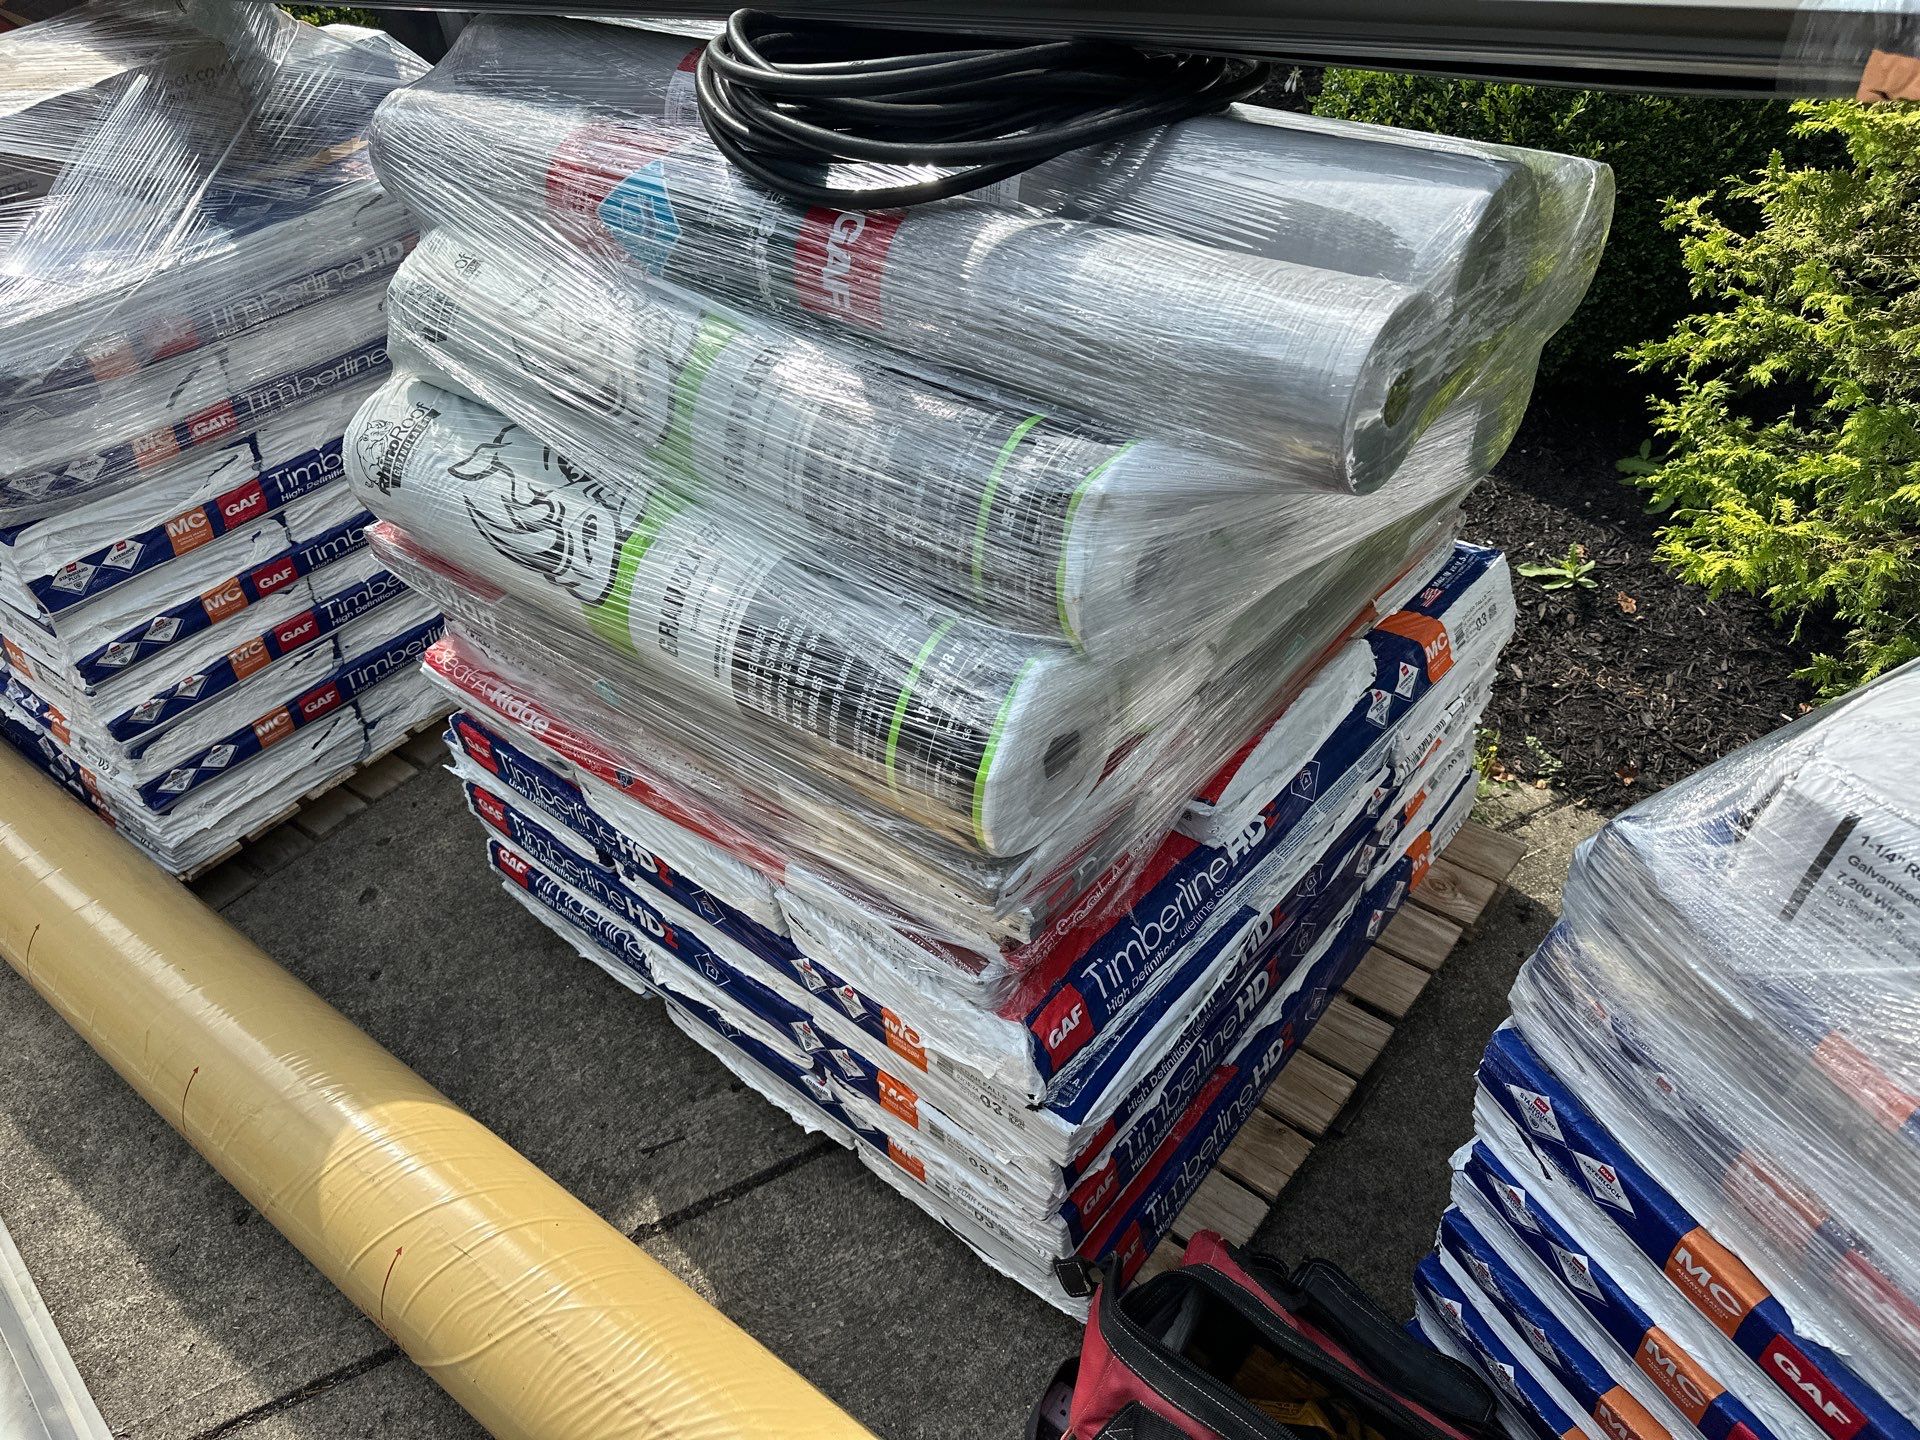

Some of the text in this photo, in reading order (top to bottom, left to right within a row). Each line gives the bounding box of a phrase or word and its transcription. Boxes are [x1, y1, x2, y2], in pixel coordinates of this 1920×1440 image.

[823, 213, 865, 310] GAF
[190, 408, 233, 439] GAF
[376, 401, 431, 498] RhinoRoof
[391, 414, 432, 478] GRANULATED
[268, 451, 343, 493] Timb
[224, 491, 264, 519] GAF
[167, 509, 208, 539] MC
[300, 528, 366, 566] Timb
[257, 564, 295, 592] GAF
[203, 584, 243, 613] MC
[321, 574, 400, 620] Timbe
[278, 618, 316, 646] GAF
[332, 612, 354, 627] High
[805, 610, 833, 651] SHES
[1474, 612, 1489, 631] 03
[230, 640, 265, 664] MC
[749, 624, 769, 663] UNDER
[1424, 631, 1450, 663] MC
[747, 662, 759, 685] USE
[795, 652, 812, 686] WOOD
[302, 689, 339, 716] GAF
[431, 643, 555, 738] Seal-A-Ridge
[808, 675, 824, 729] SHINGLES
[255, 711, 291, 737] MC
[793, 700, 803, 730] SLATE
[828, 693, 842, 747] ATERPROOF
[462, 736, 492, 760] GAF
[474, 797, 506, 823] GAF
[496, 847, 529, 875] GAF
[518, 840, 541, 859] High
[1861, 836, 1906, 864] 1-1/4"
[535, 889, 557, 907] High
[1824, 885, 1846, 908] Ring
[1836, 870, 1905, 920] 7,200 Wire
[1106, 984, 1131, 1015] High
[1129, 936, 1178, 989] Definition
[1048, 1002, 1084, 1050] GAF
[1126, 1038, 1192, 1114] High Definition
[977, 1093, 1007, 1117] 03
[1519, 1092, 1557, 1132] STAINGUARD
[1130, 1143, 1153, 1172] High
[1083, 1171, 1117, 1216] GAF
[1581, 1161, 1623, 1201] LAYERLOCK
[1155, 1210, 1177, 1238] High
[1673, 1248, 1746, 1319] MC
[1644, 1338, 1706, 1407] MC
[1778, 1350, 1852, 1422] GAF
[1600, 1405, 1638, 1440] M
